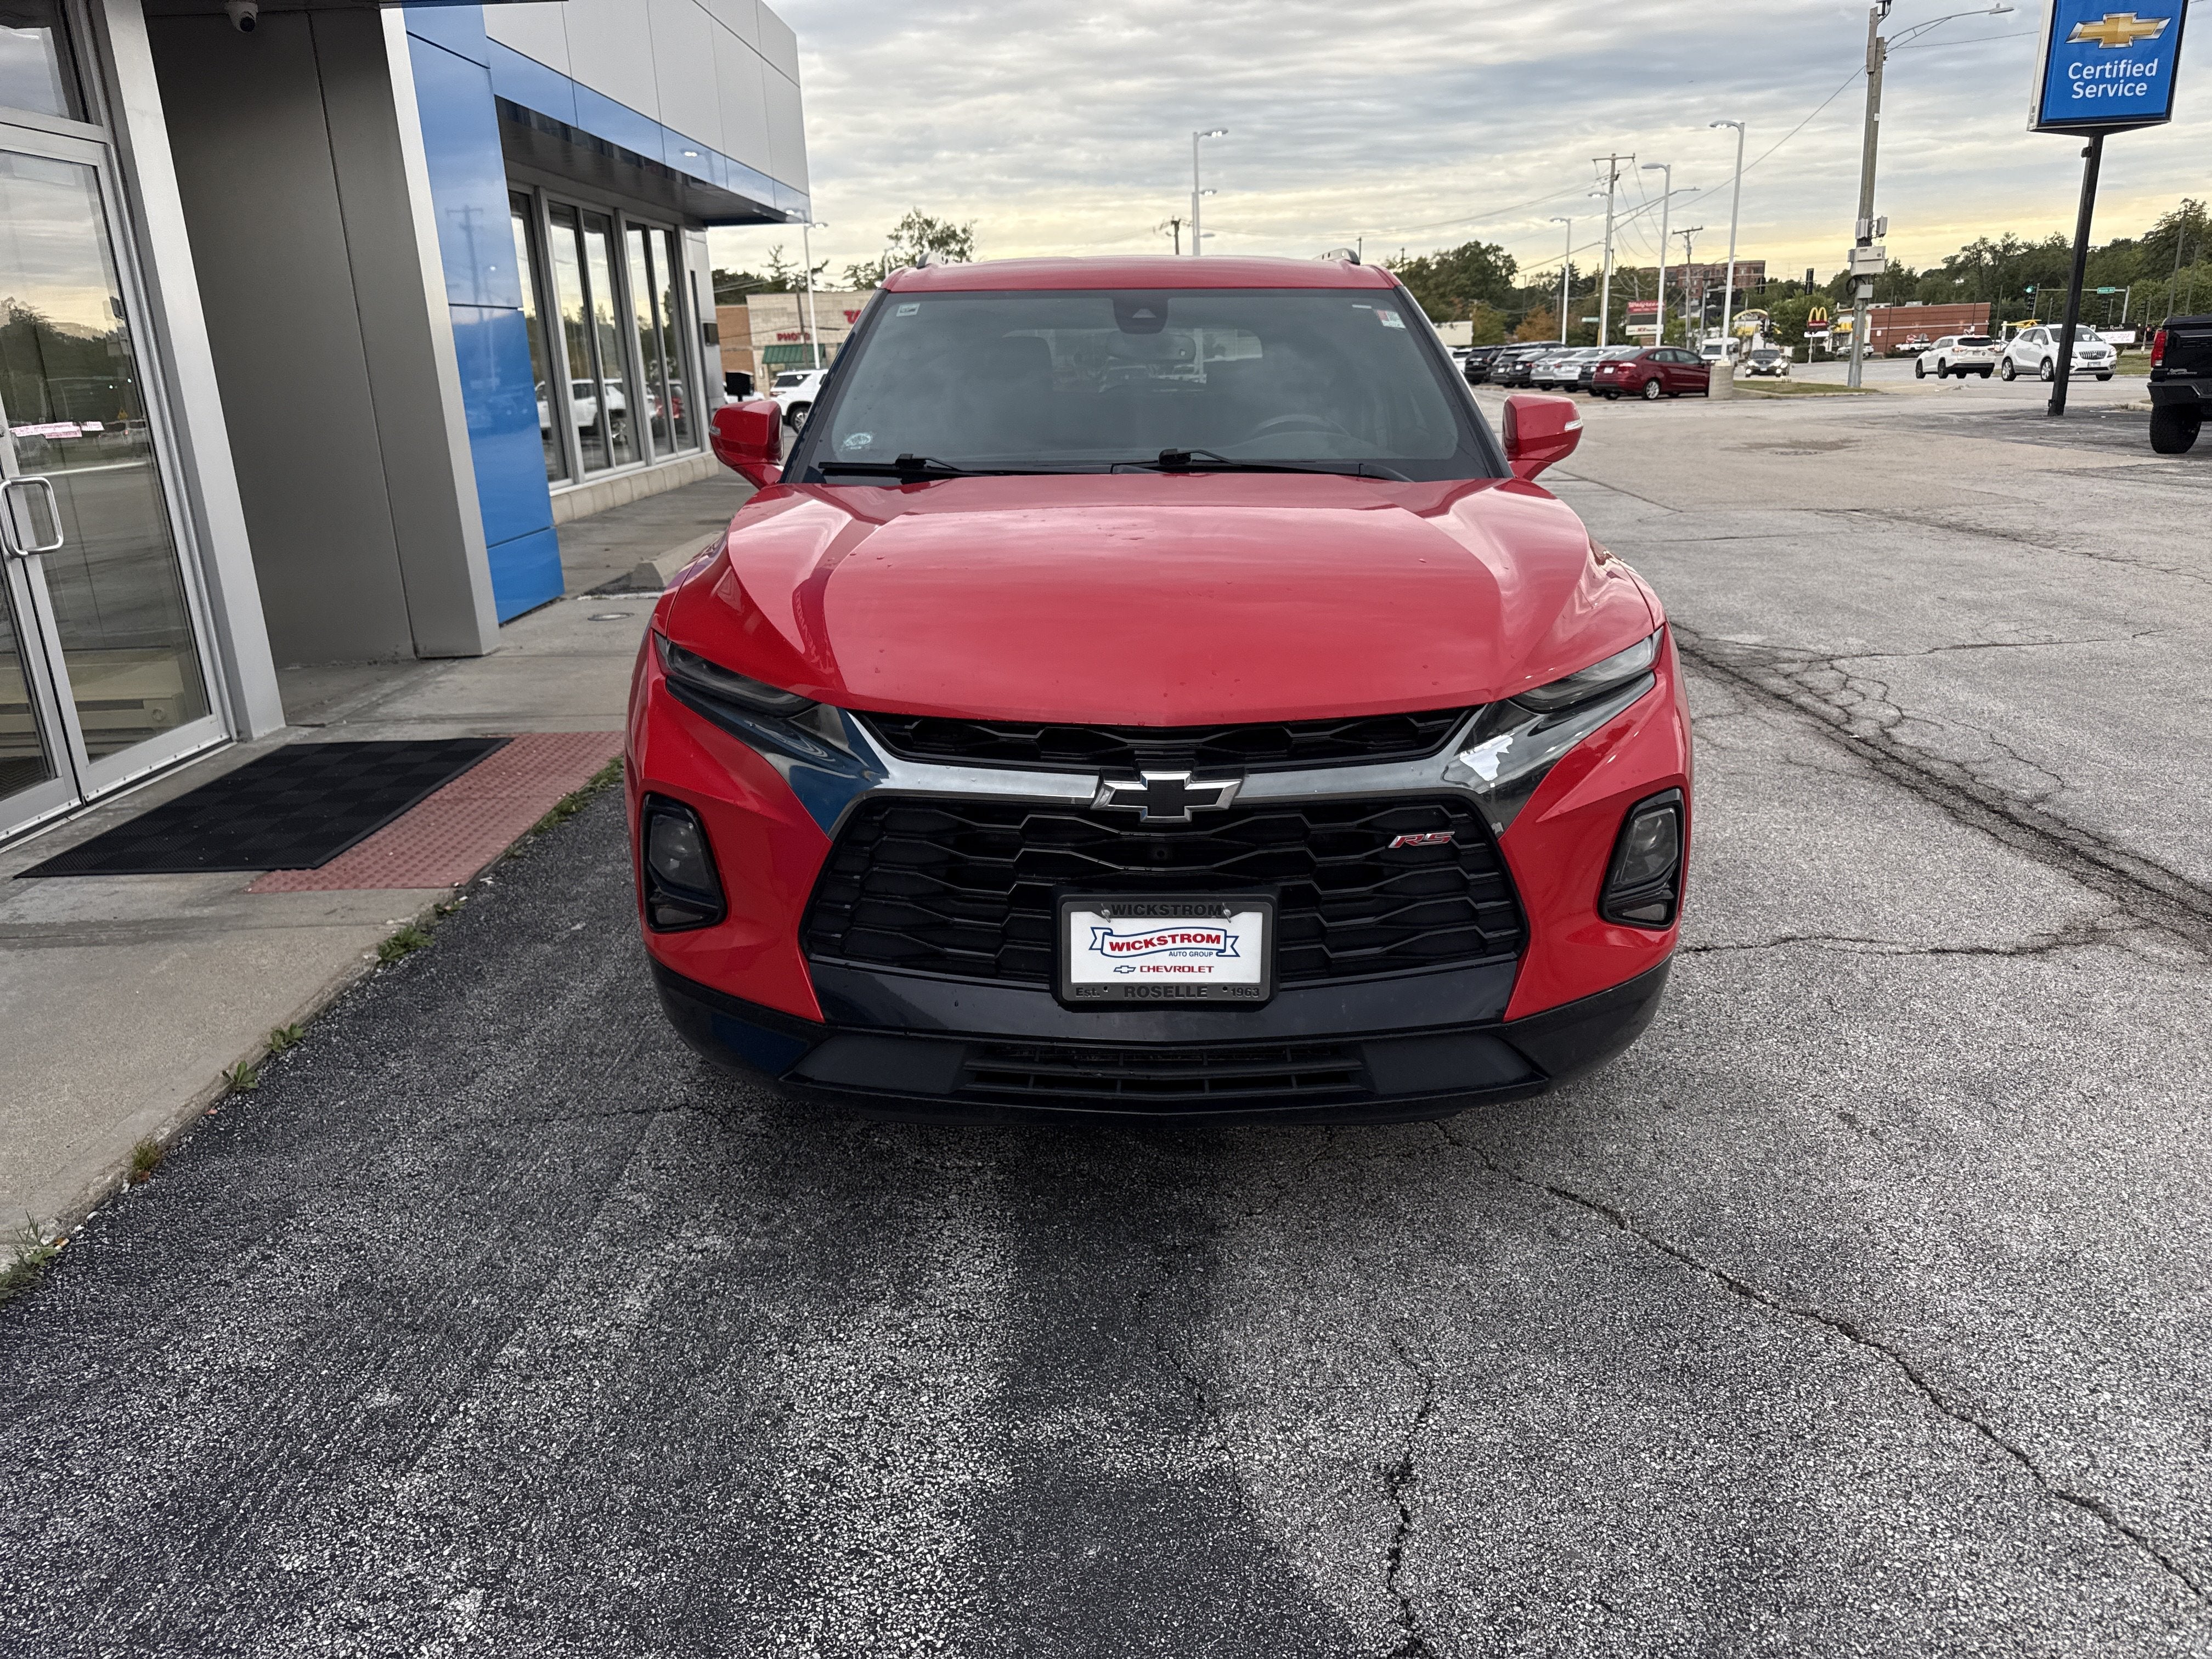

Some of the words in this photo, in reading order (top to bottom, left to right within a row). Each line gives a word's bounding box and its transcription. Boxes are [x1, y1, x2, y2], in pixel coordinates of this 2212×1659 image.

[2068, 58, 2158, 80] Certified
[2072, 80, 2147, 99] Service
[1388, 831, 1455, 848] RS
[1111, 904, 1222, 917] WICKSTROM
[1109, 933, 1221, 952] WICKSTROM
[1075, 988, 1100, 997] Est.
[1124, 986, 1208, 998] ROSELLE
[1231, 988, 1260, 997] 1963
